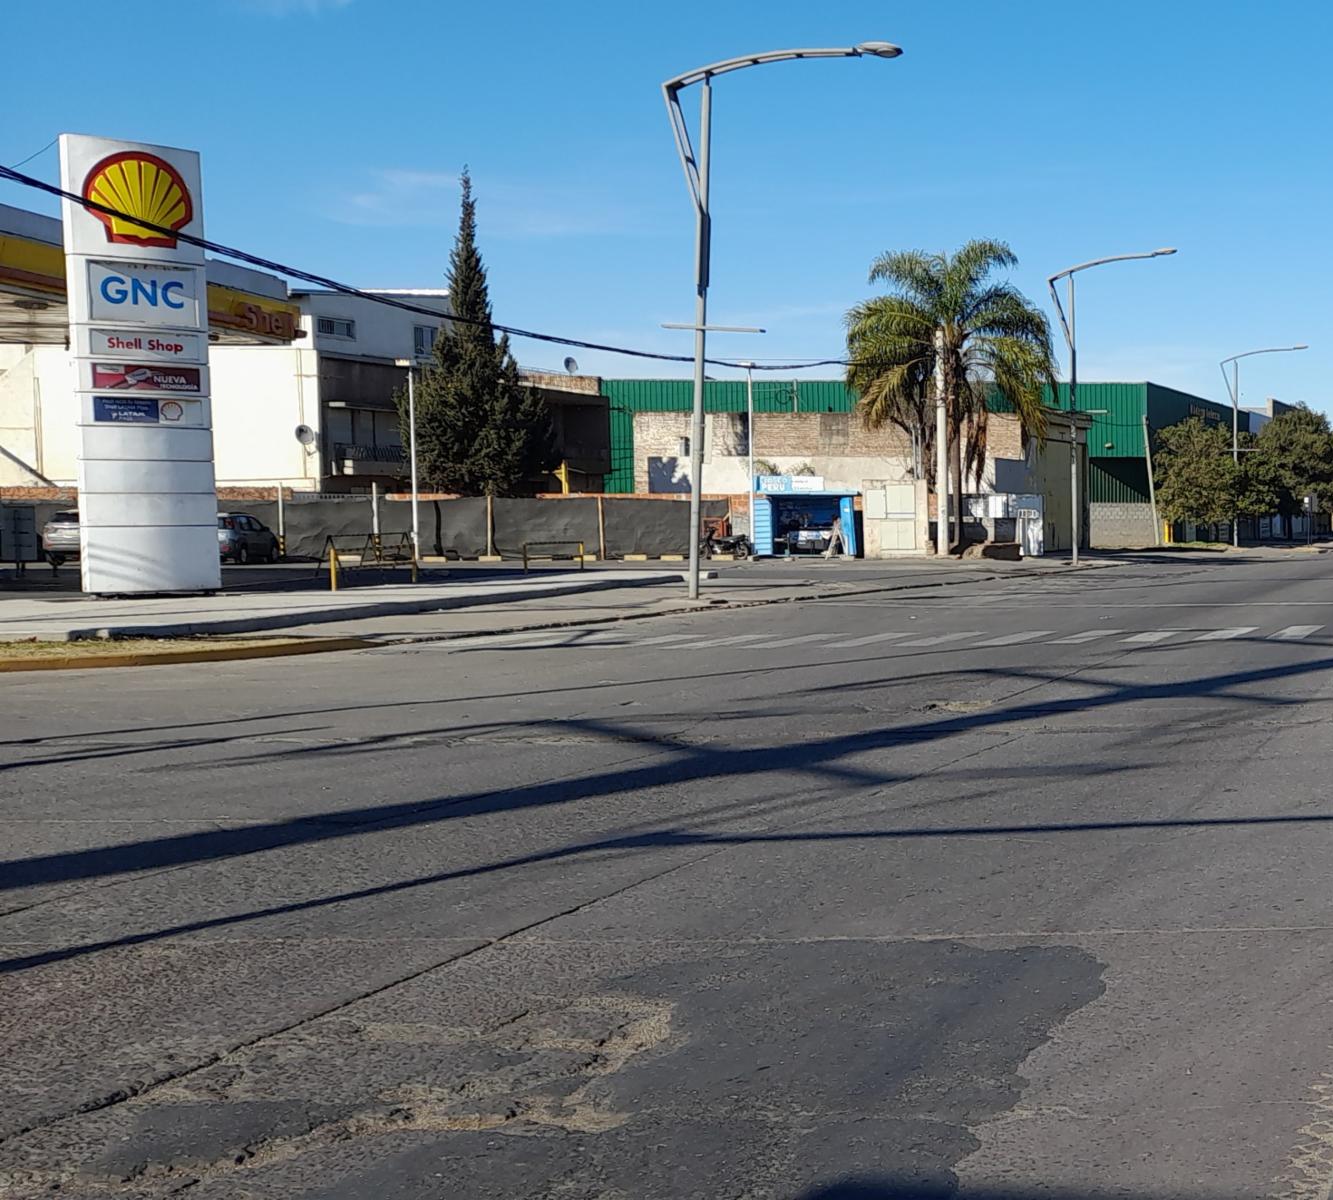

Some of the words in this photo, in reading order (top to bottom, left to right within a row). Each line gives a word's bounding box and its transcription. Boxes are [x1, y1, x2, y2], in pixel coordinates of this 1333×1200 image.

[100, 275, 185, 310] GNC
[107, 337, 142, 350] Shell
[147, 339, 184, 354] Shop
[153, 375, 187, 384] NUEVA
